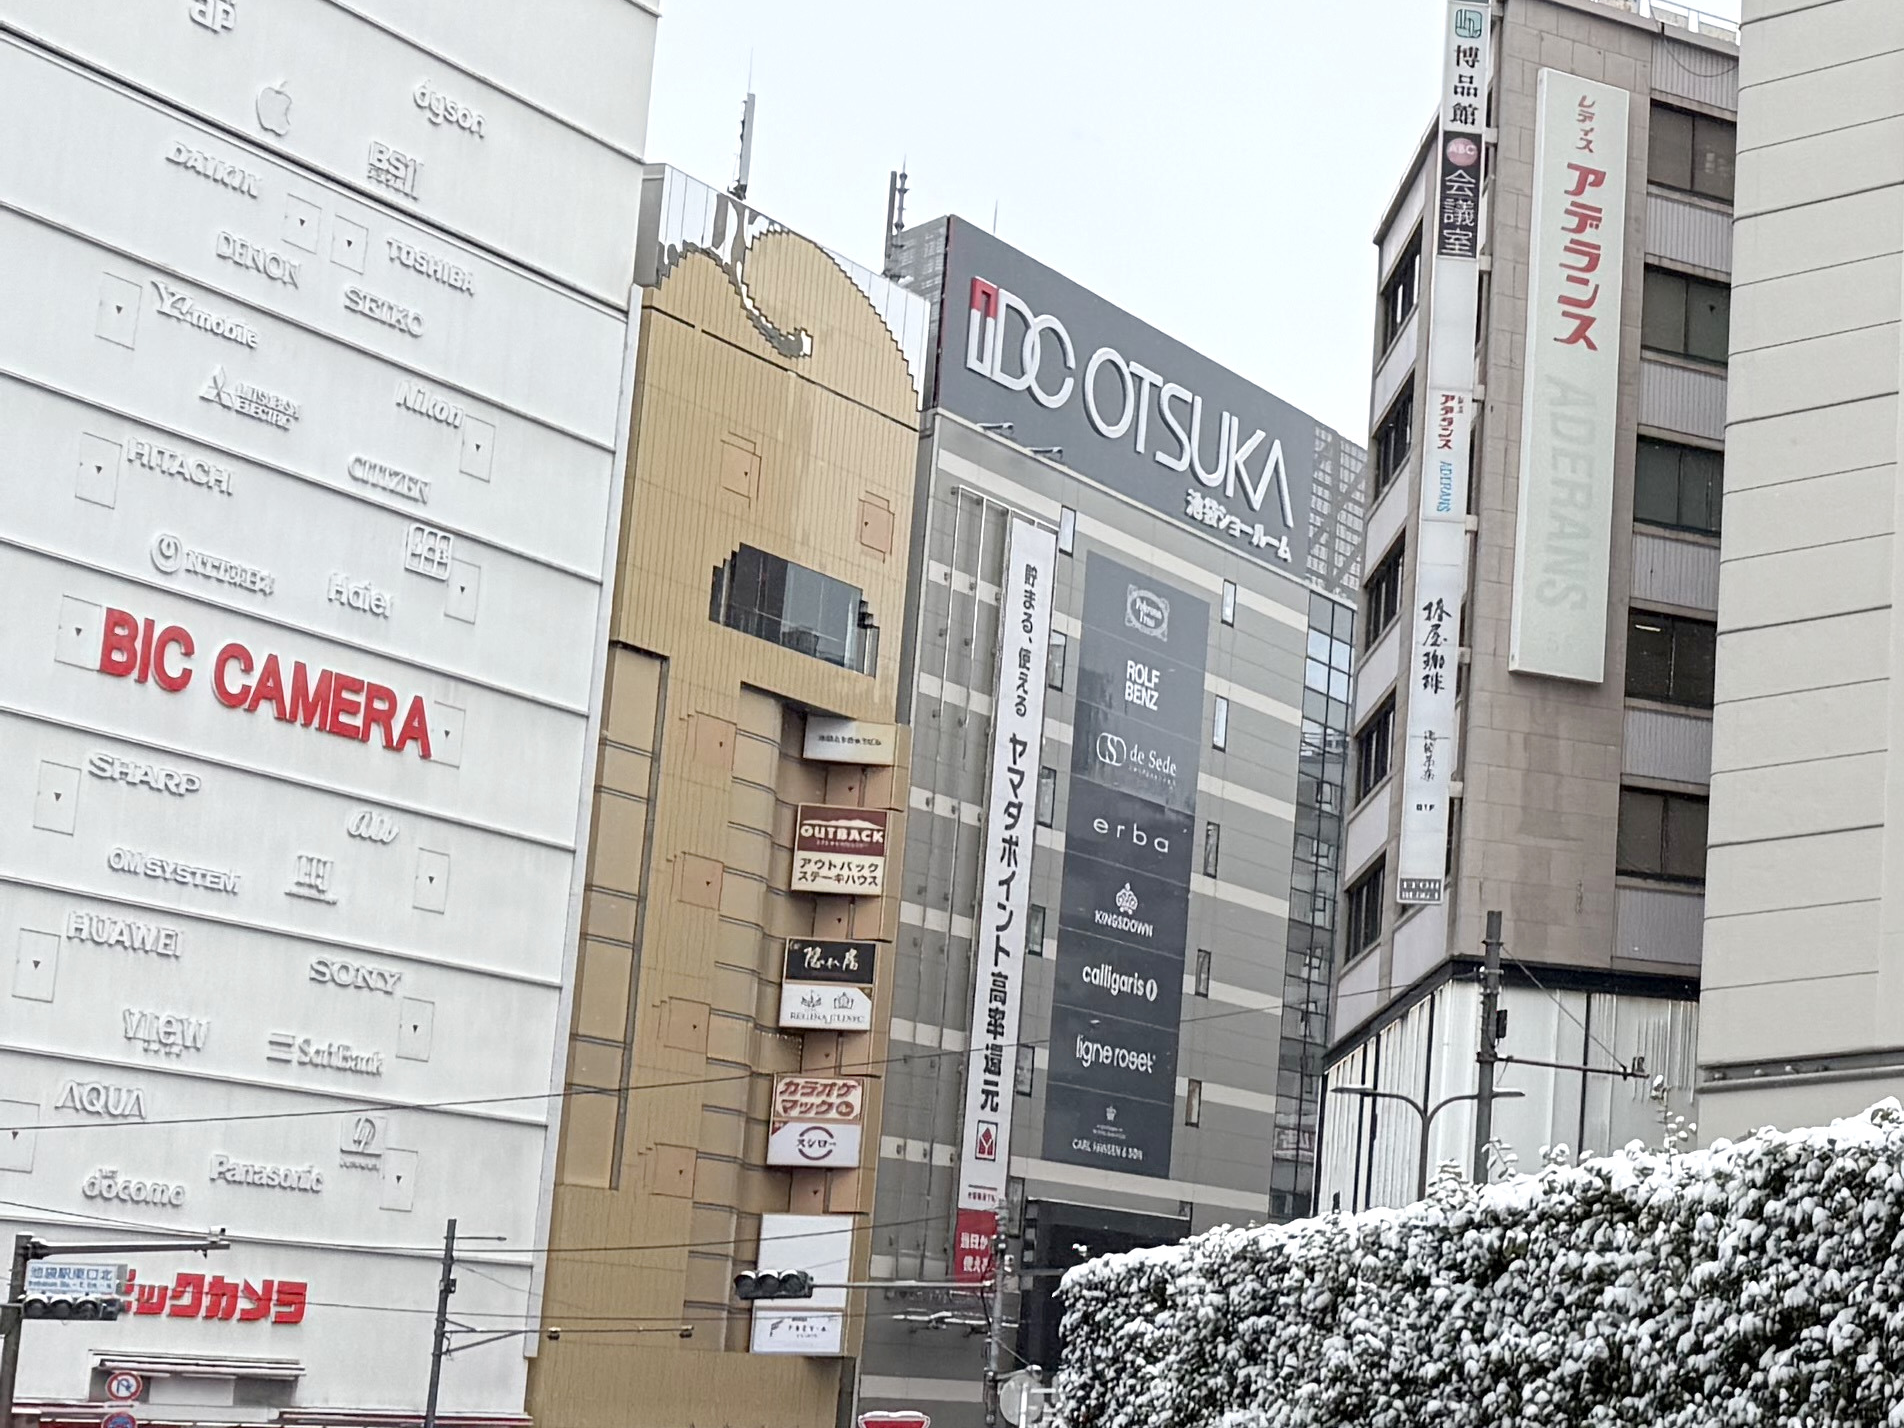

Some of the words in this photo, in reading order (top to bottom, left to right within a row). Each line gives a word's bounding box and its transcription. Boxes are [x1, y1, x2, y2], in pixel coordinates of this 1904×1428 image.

[1451, 44, 1480, 126] 博品館
[413, 79, 487, 139] dyson
[1575, 94, 1596, 153] レディス
[165, 140, 263, 198] DAIKIN
[1446, 143, 1476, 157] ABC
[1441, 169, 1476, 257] 会議室
[215, 230, 301, 289] DENON
[386, 237, 476, 297] TOSHIBA
[1553, 161, 1608, 351] アデランス
[343, 283, 426, 338] SEIKO
[395, 376, 464, 428] Nikon
[1084, 346, 1294, 529] OTSUKA
[126, 436, 233, 496] HITACHI
[348, 453, 432, 505] CITIZEN
[1534, 375, 1597, 610] ADERANS
[1185, 488, 1292, 563] 池袋ショールーム
[327, 572, 396, 620] Haier
[100, 607, 195, 691] BIC
[213, 643, 431, 759] CAMERA
[1124, 680, 1159, 711] BENZ
[1126, 659, 1160, 689] ROLF
[89, 753, 201, 796] SHARP
[1129, 744, 1145, 766] de
[1148, 749, 1177, 777] Sede
[800, 824, 885, 844] OUTBACK
[1092, 815, 1170, 855] erba
[108, 846, 143, 874] OM
[145, 857, 241, 896] SYSTEM
[797, 871, 879, 888] ステーキハウス
[800, 857, 879, 873] アウトバック
[67, 911, 184, 959] HUAWEI
[309, 956, 402, 995] SONY
[1082, 962, 1144, 997] calligaris
[298, 1038, 386, 1075] SoftBank
[1076, 1034, 1113, 1068] ligne
[1113, 1046, 1153, 1074] roset
[55, 1080, 146, 1120] AQUA
[779, 1079, 858, 1097] カラオケ
[781, 1099, 836, 1115] マック
[797, 1138, 837, 1149] スシロー
[82, 1170, 186, 1206] docomo
[209, 1154, 325, 1194] Panasonic
